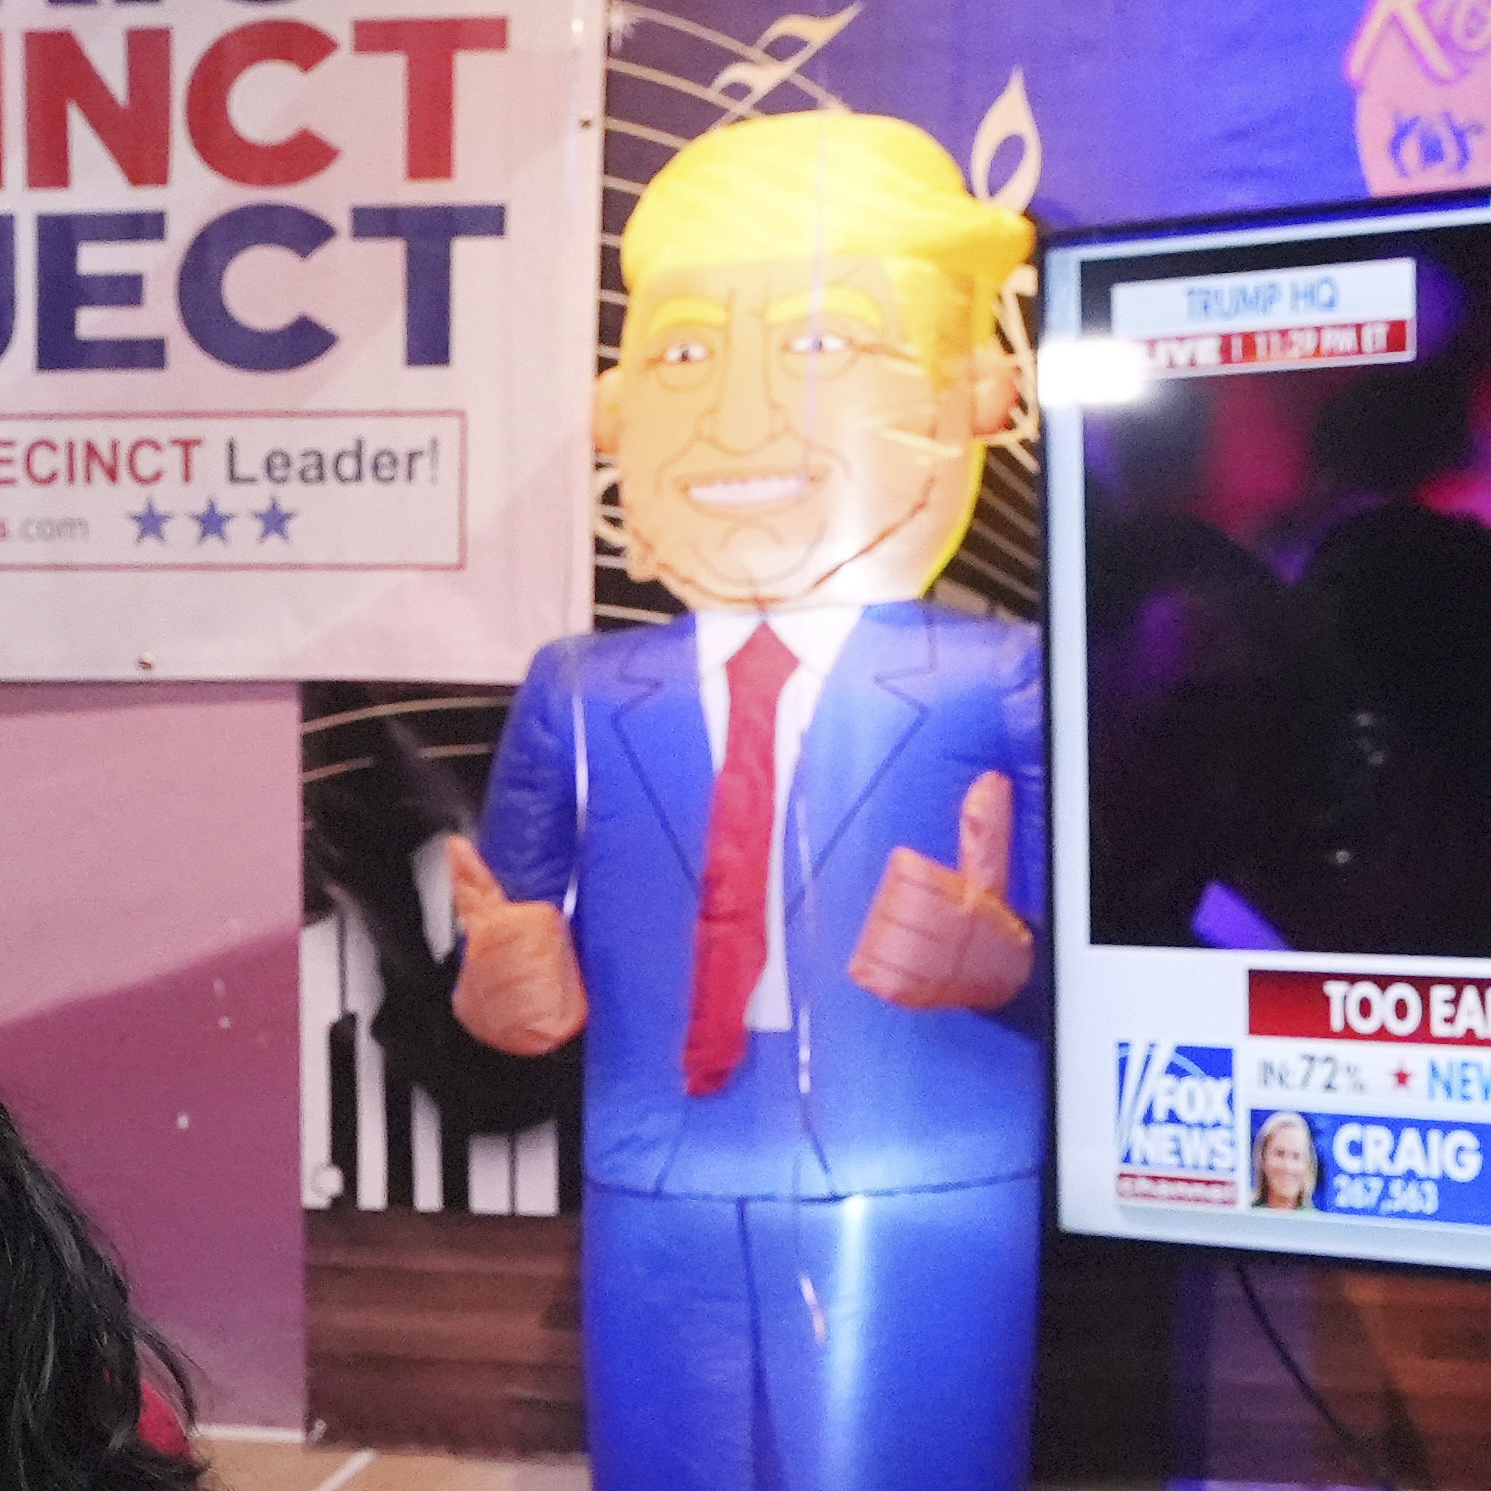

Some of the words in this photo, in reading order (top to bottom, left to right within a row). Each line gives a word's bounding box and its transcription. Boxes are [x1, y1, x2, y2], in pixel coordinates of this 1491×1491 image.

[1187, 283, 1281, 320] TRUMP
[1290, 276, 1341, 312] HQ
[228, 436, 440, 486] Leader!
[1323, 979, 1423, 1037] TOO
[1151, 1076, 1234, 1126] FOX
[1124, 1123, 1236, 1170] NEWS
[1331, 1122, 1484, 1182] CRAIG
